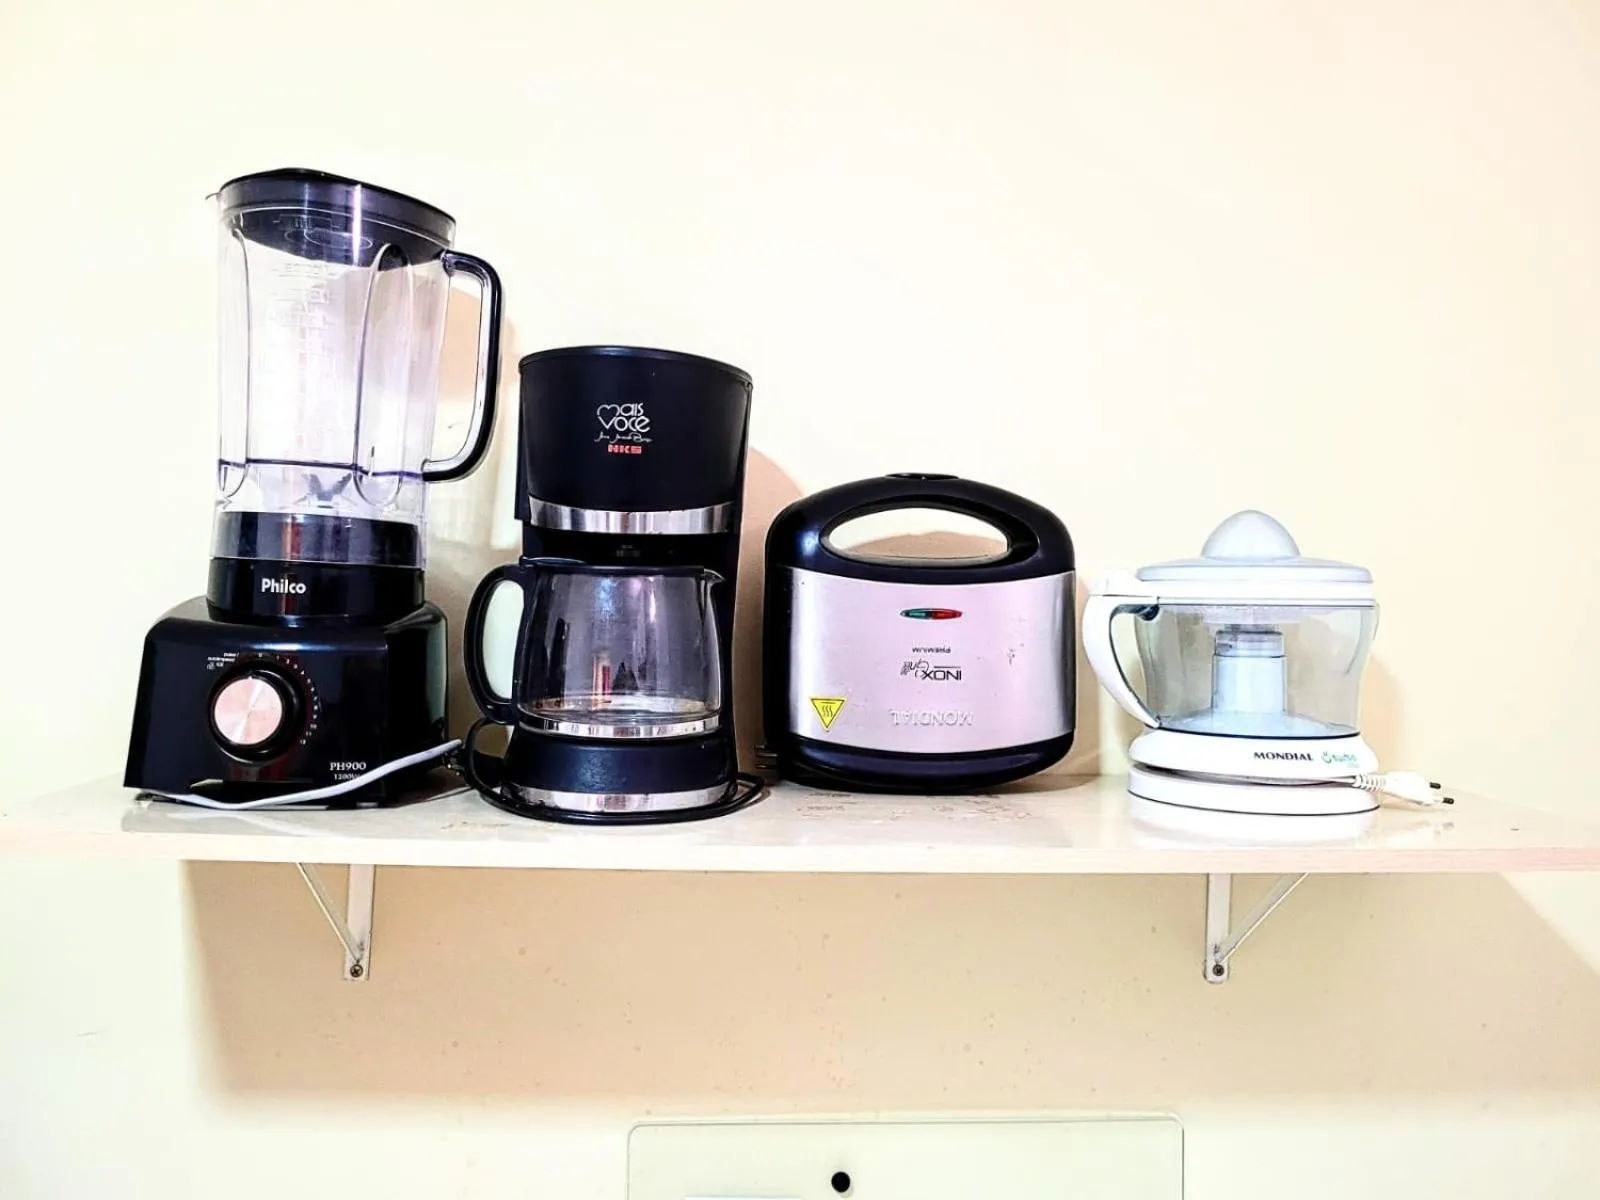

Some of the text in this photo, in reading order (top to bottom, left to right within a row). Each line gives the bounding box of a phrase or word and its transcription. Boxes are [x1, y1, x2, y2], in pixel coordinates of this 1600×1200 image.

[261, 577, 307, 594] Philco
[921, 669, 962, 681] INOX
[888, 708, 974, 727] MONDIAL
[1253, 751, 1314, 762] MONDIAL
[329, 761, 367, 771] PH900
